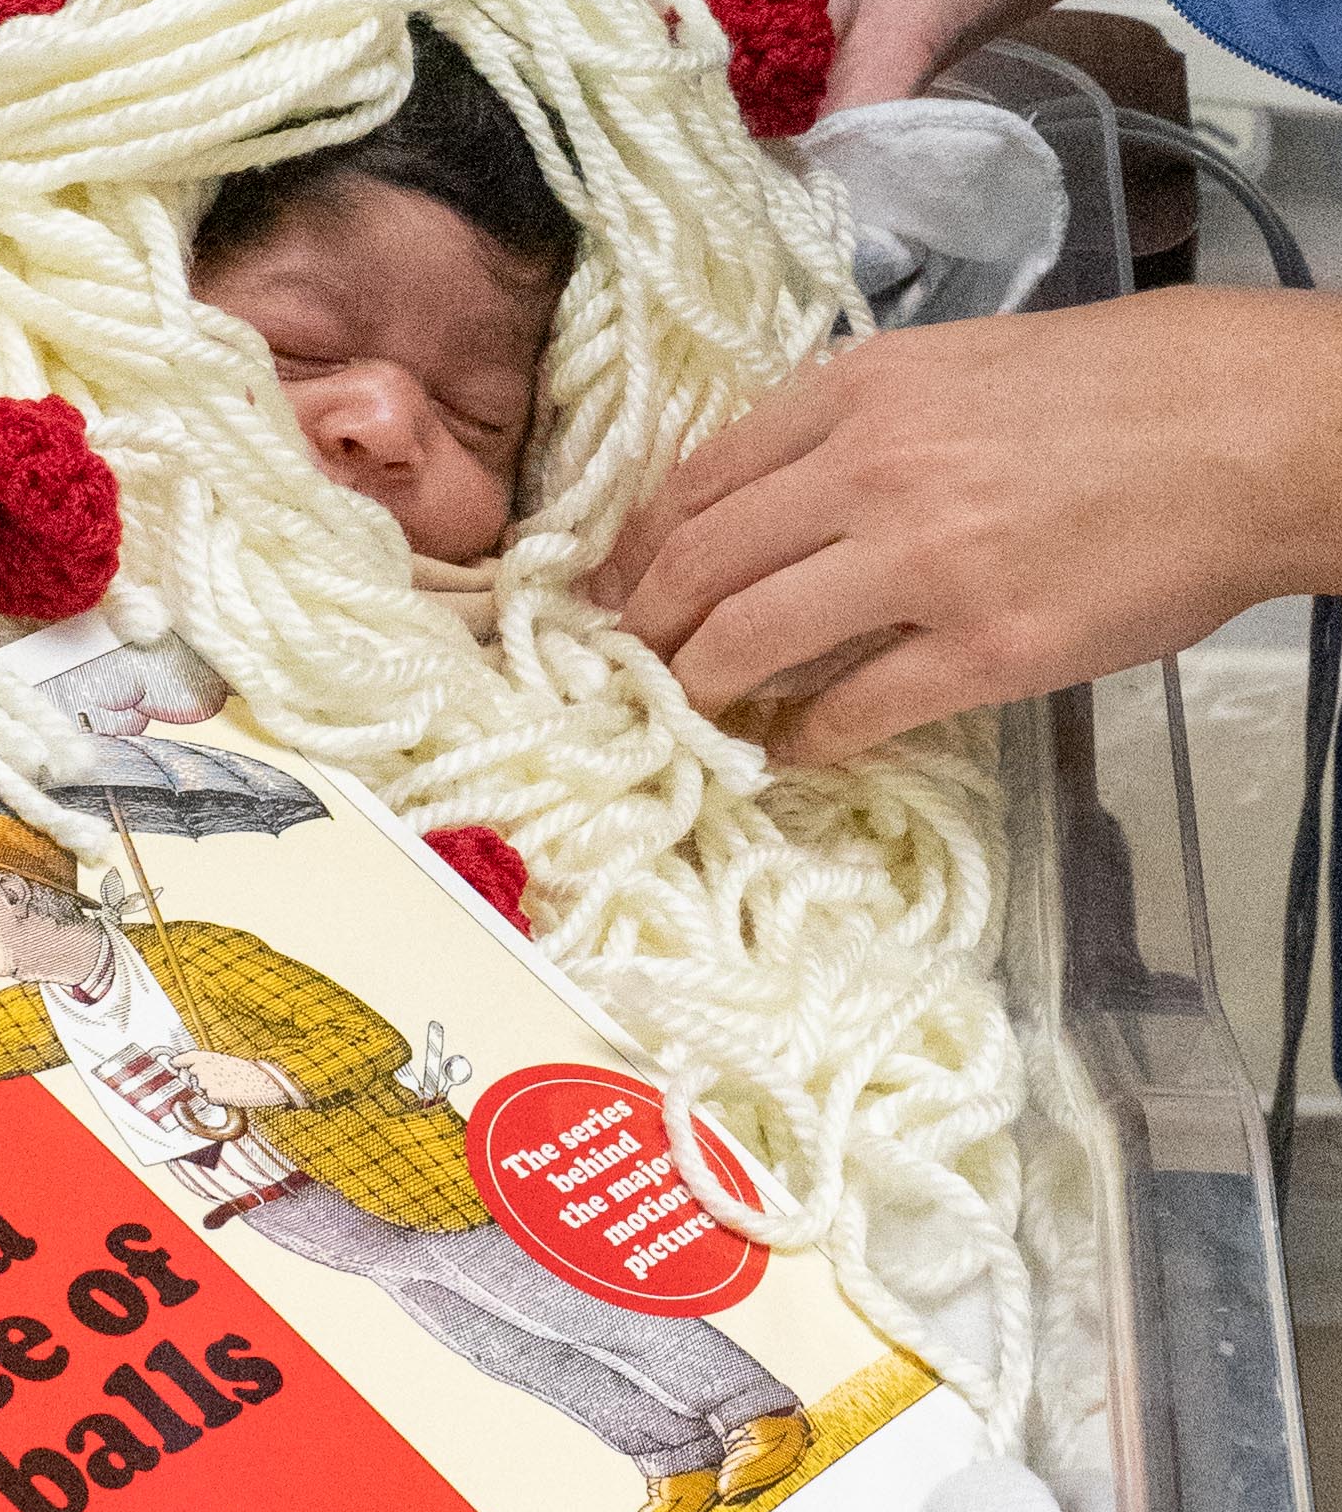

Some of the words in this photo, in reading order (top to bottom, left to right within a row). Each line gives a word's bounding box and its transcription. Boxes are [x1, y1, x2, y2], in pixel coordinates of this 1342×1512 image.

[501, 1140, 561, 1180] The
[557, 1099, 634, 1151] series
[547, 1130, 643, 1194] behind
[559, 1193, 610, 1230] the
[603, 1183, 693, 1247] motion
[66, 1222, 201, 1337] of
[624, 1210, 716, 1282] picture
